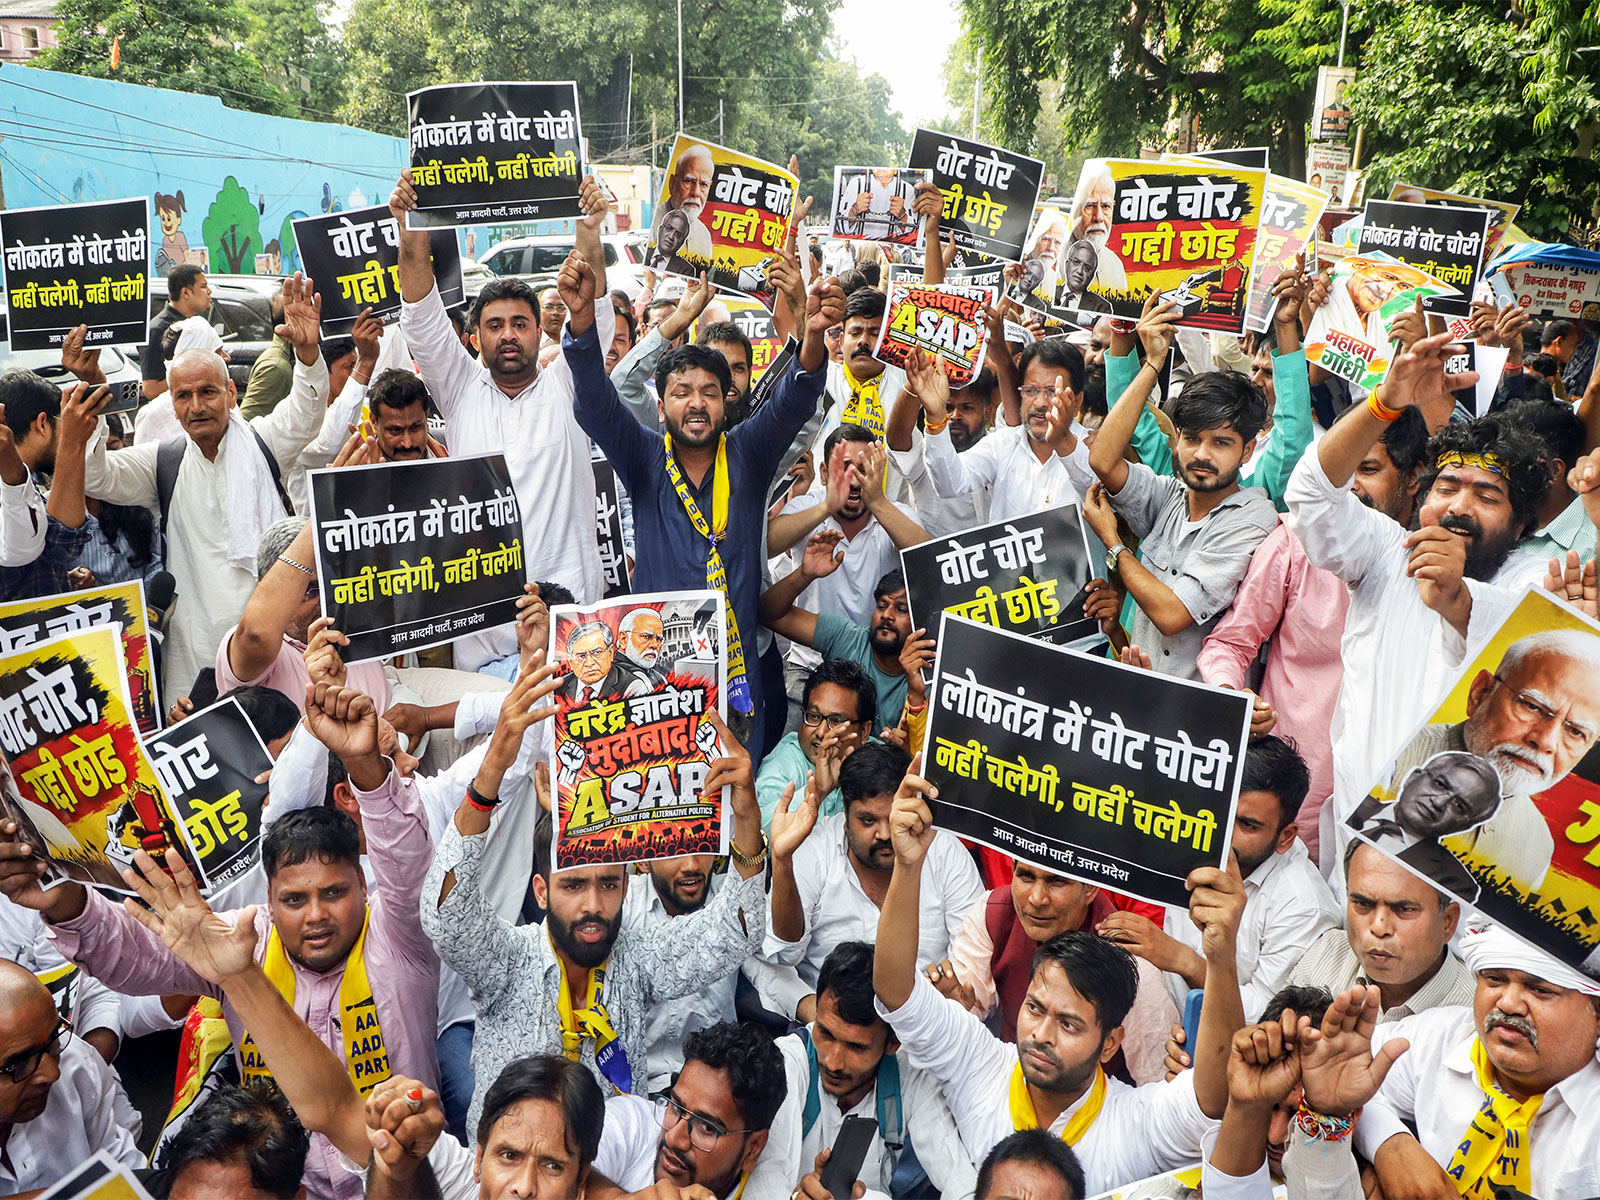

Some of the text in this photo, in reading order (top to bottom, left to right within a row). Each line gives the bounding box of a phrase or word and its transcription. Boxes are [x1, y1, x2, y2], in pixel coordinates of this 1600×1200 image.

[412, 110, 574, 148] लोकतंत्र में वोट चोरी
[410, 151, 576, 186] नहीं चलेगी, नहीं चलेगी
[715, 167, 763, 206] वोट
[937, 140, 1016, 191] वोट चोर
[456, 211, 470, 219] आम
[471, 208, 491, 218] आदमी
[492, 206, 508, 216] पार्टी,
[522, 205, 538, 215] प्रदेश
[938, 183, 1008, 237] द्दी छोड़
[1119, 177, 1242, 222] वोट चोर,
[327, 216, 377, 258] वोट
[712, 209, 760, 244] गद्दी
[1120, 222, 1240, 266] गद्दी छोड़
[1362, 221, 1481, 257] लोकतंत्र में वोट चोरी
[5, 228, 146, 270] लोकतंत्र में वोट चोरी
[10, 273, 145, 308] नहीं चलेगी, नहीं चलेगी
[336, 260, 388, 305] गद्दी
[1435, 264, 1473, 285] चलेगी
[890, 304, 978, 356] ASAP
[1325, 327, 1376, 362] महात्मा
[321, 486, 519, 553] लोकतंत्र में वोट चोरी
[330, 538, 522, 605] नहीं चलेगी, नहीं चलेगी
[936, 524, 1046, 586] वोट चोर
[1001, 576, 1061, 624] छोड़
[390, 612, 485, 644] आम आदमी पार्टी, उत्तर प्रदेश
[22, 664, 99, 734] चोर,
[566, 685, 703, 739] नरेंद्र ज्ञानेश
[585, 716, 698, 777] मुर्दाबाद!
[941, 667, 1233, 792] लोकतंत्र में वोट चोरी
[21, 735, 128, 813] गद्दी छोड़
[935, 736, 1217, 853] नहीं चलेगी, नहीं चलेगी
[566, 760, 713, 835] ASAP
[567, 808, 713, 835] ASSOCIATION OF STUDENT FOR ALTERNATIVE POLITICS
[992, 827, 1130, 882] आम आदमी पार्टी, उत्तर प्रदेश
[355, 1012, 380, 1032] AA
[351, 1035, 385, 1058] AAD
[354, 1057, 391, 1079] PART
[598, 1045, 614, 1066] AAM
